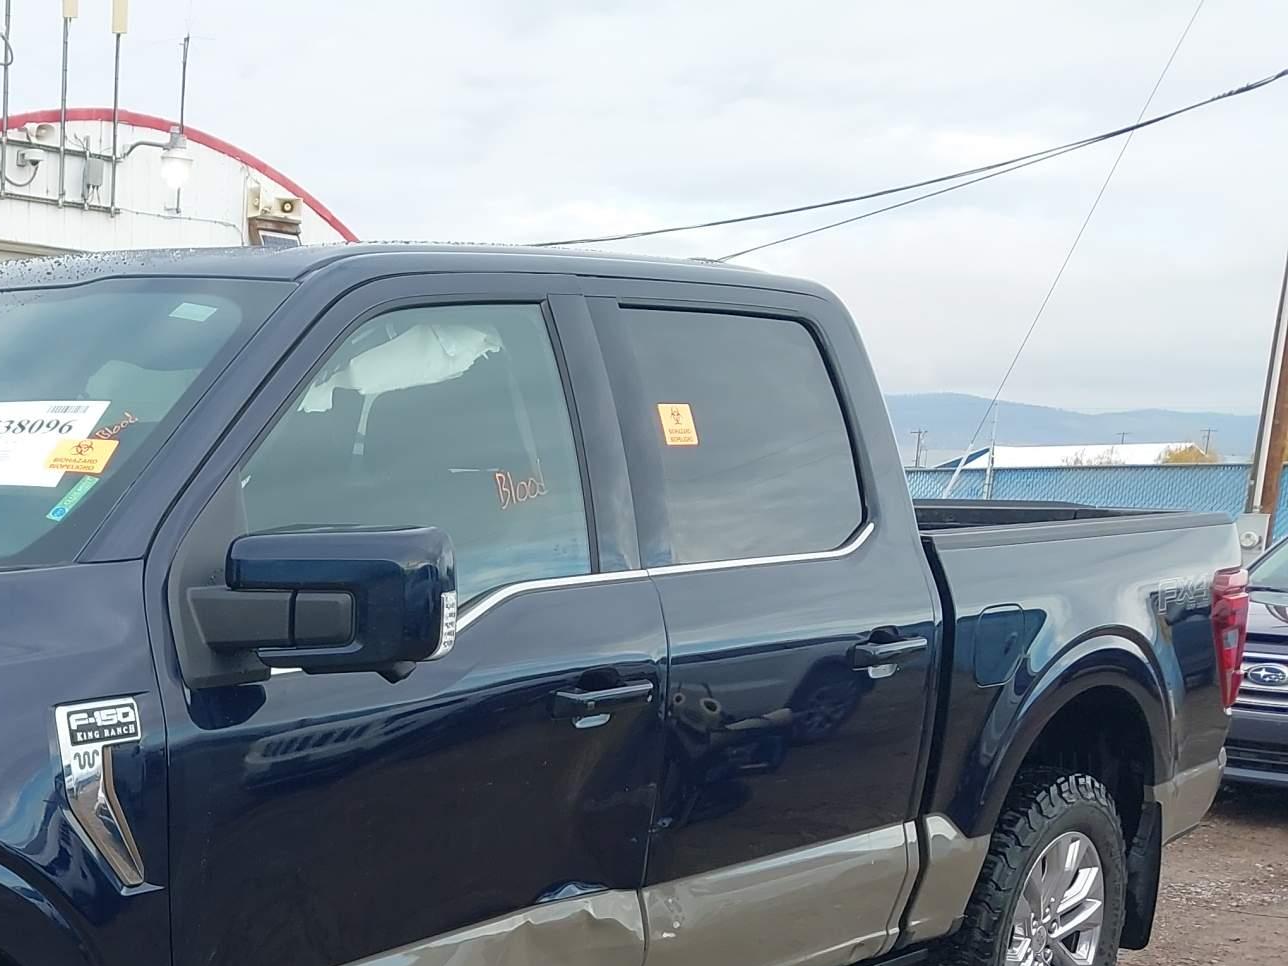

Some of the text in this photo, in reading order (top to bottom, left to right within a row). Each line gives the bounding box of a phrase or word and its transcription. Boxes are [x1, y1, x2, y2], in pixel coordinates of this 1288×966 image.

[96, 409, 139, 439] Blood
[495, 458, 549, 510] Blood
[69, 706, 136, 730] F-150
[76, 723, 136, 742] KING RANCH
